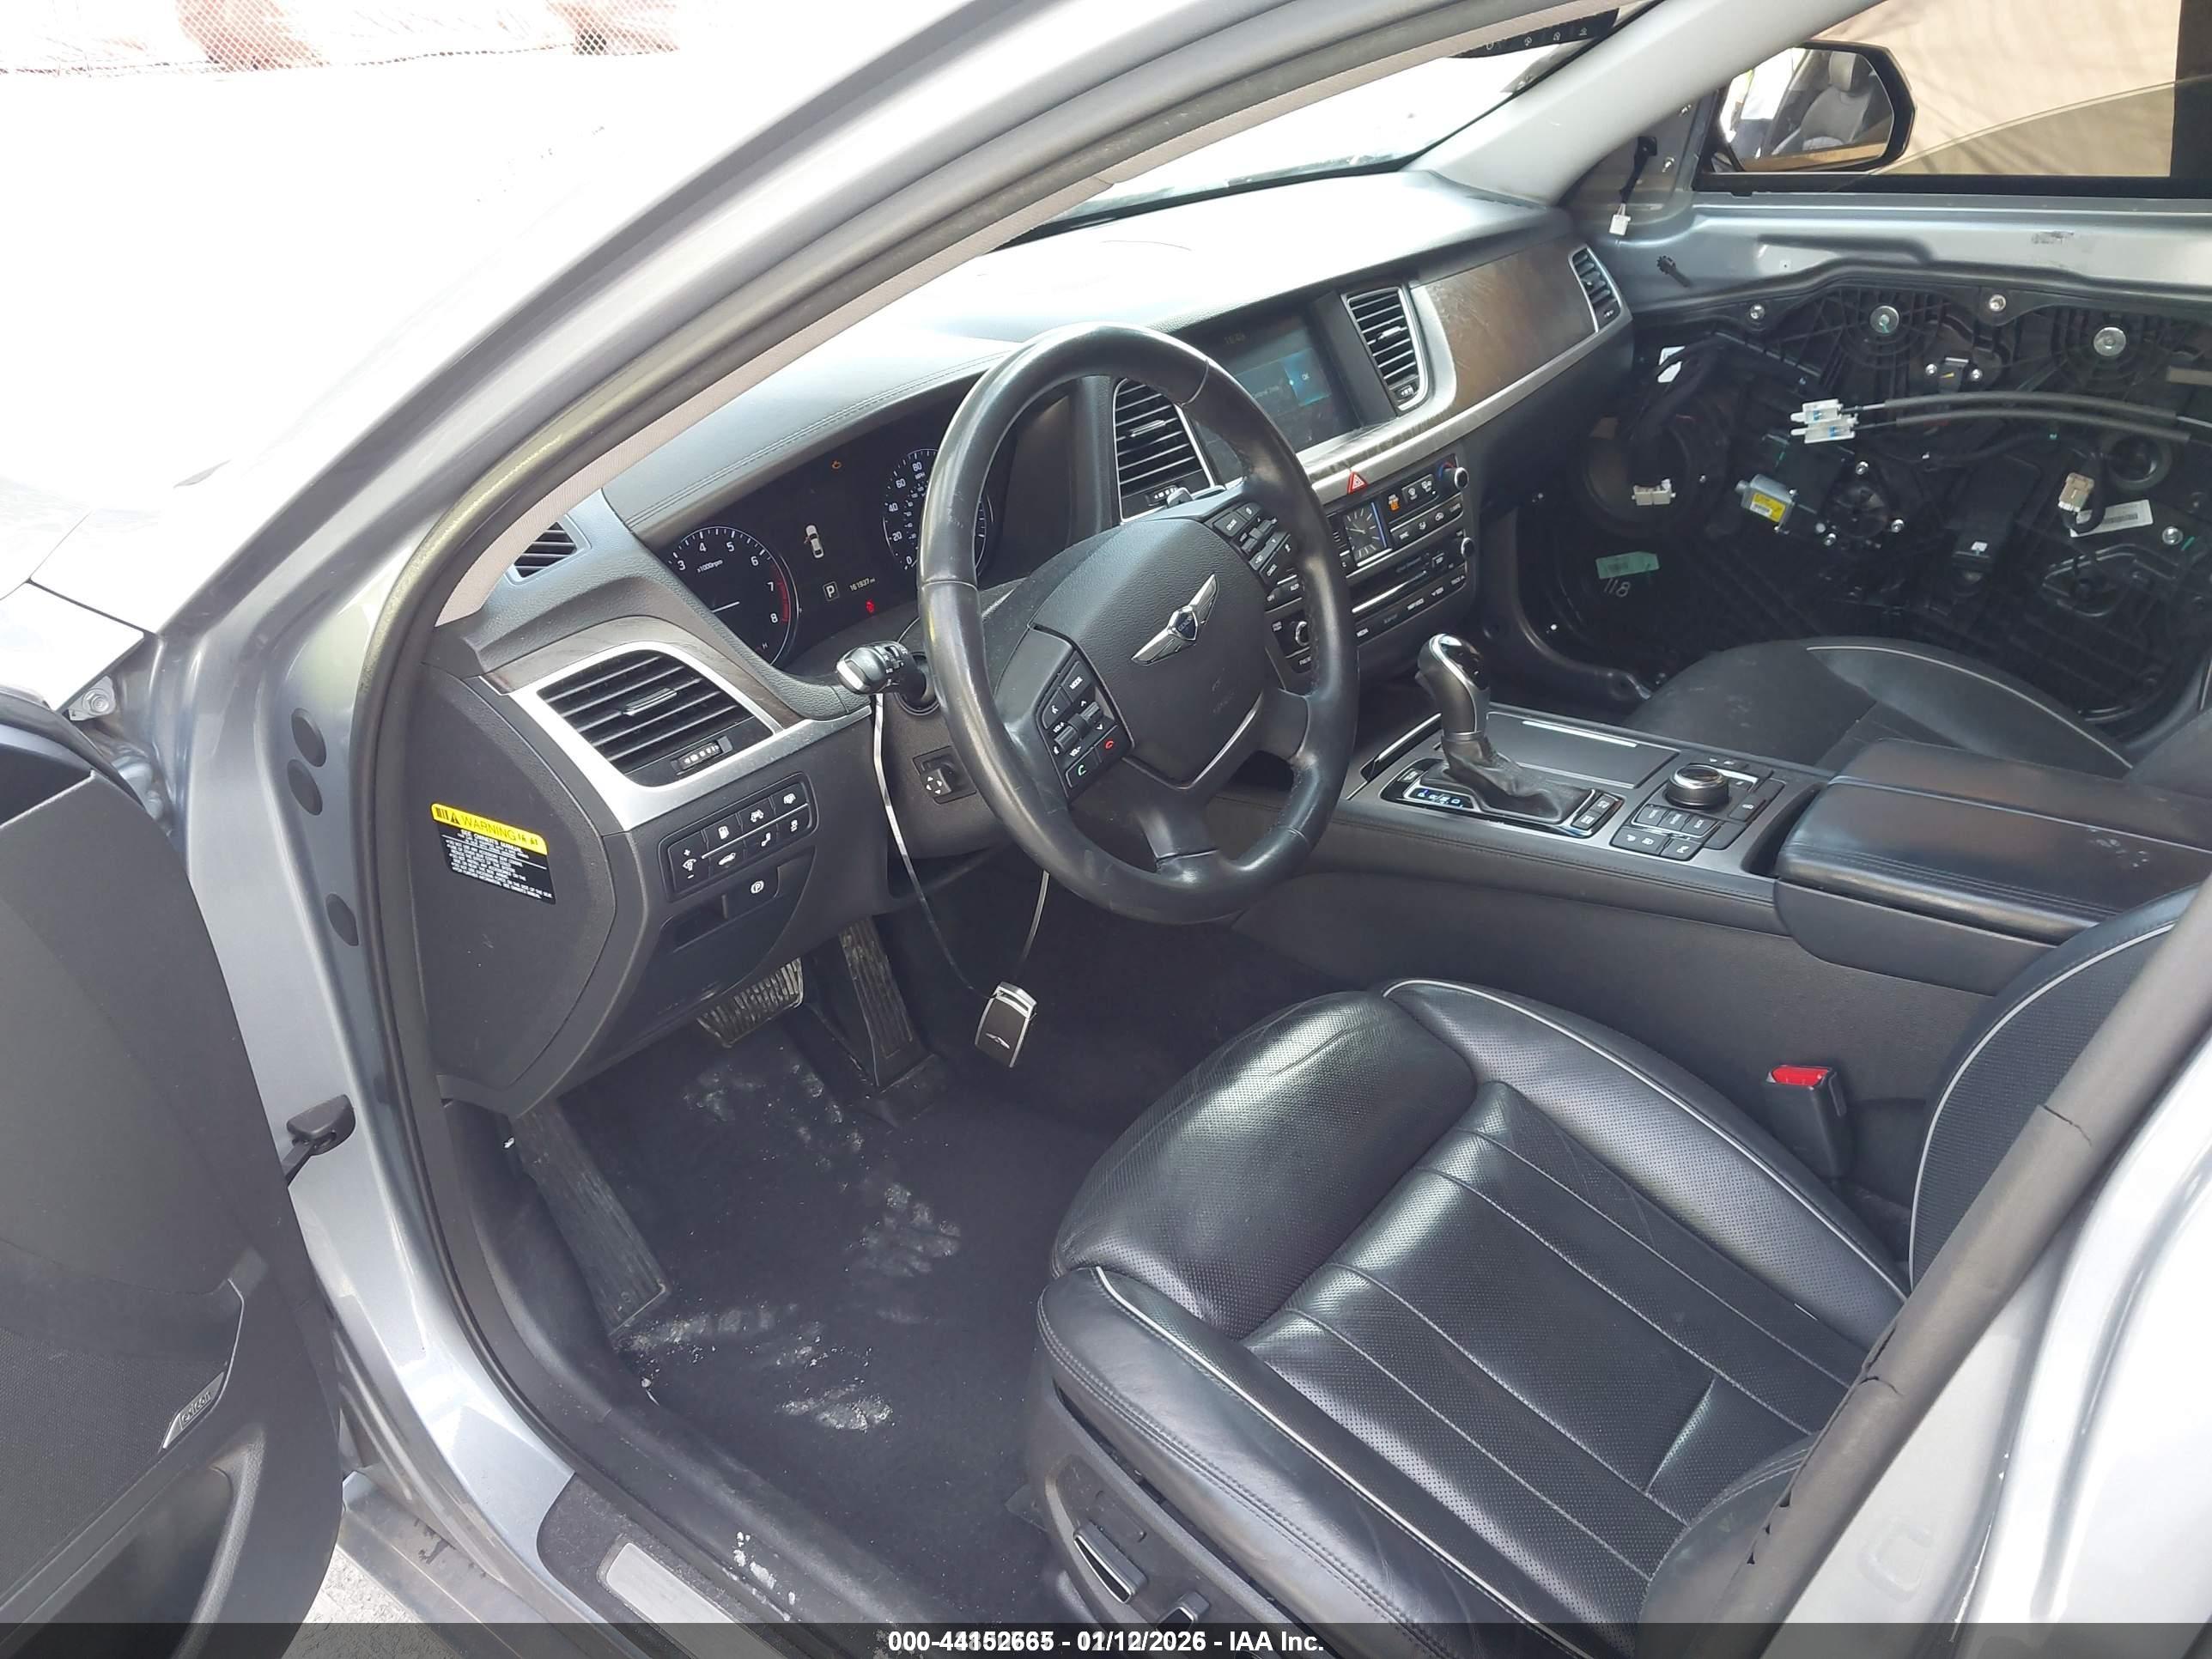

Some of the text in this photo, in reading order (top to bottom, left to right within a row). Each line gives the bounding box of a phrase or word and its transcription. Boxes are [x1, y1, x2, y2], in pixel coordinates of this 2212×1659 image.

[912, 461, 923, 472] 80
[895, 478, 906, 489] 60
[888, 502, 899, 513] 40
[891, 531, 902, 542] 20
[699, 542, 708, 553] 4
[726, 541, 735, 552] 5
[677, 560, 686, 571] 3
[750, 556, 759, 567] 6
[906, 555, 913, 565] 0
[767, 581, 775, 592] 7
[770, 612, 778, 623] 8
[460, 815, 516, 841] WARNING
